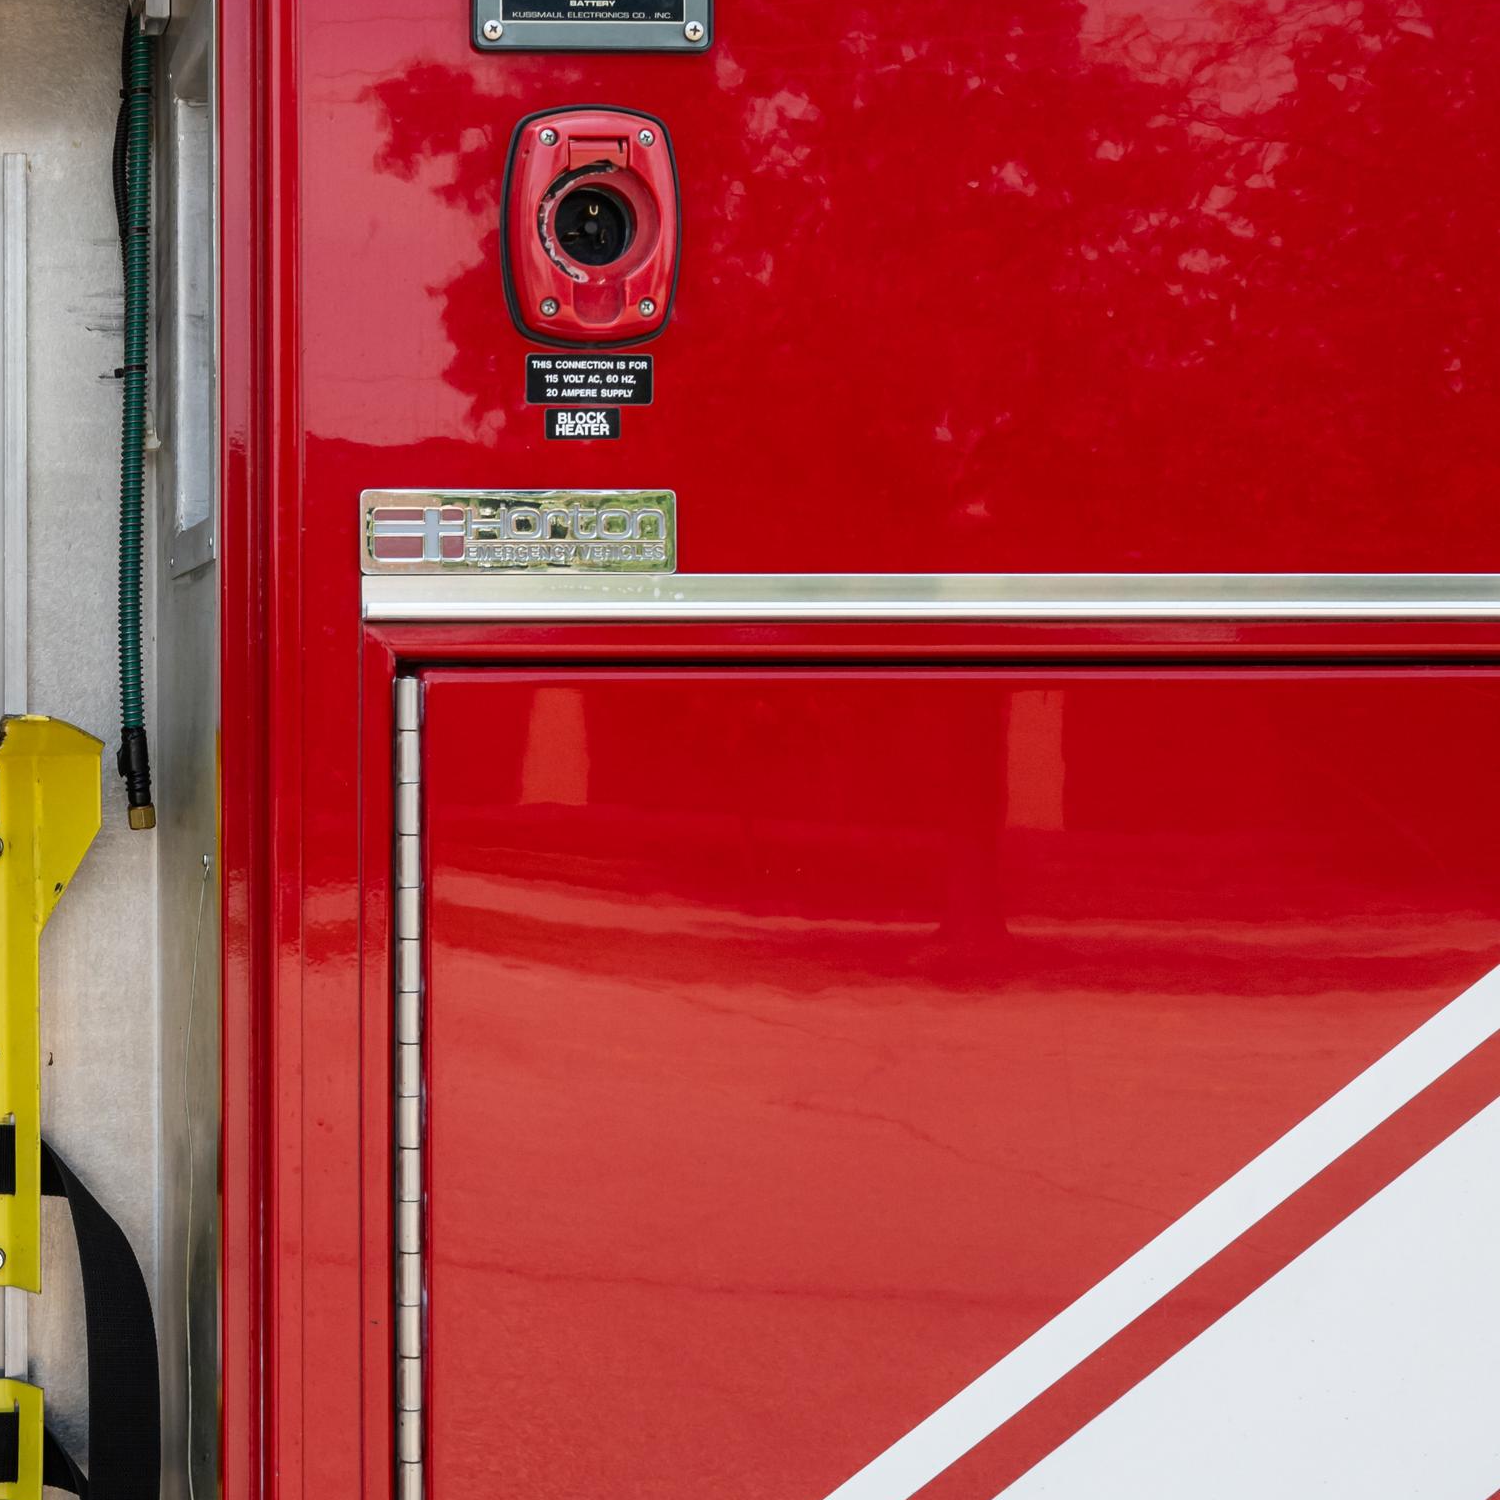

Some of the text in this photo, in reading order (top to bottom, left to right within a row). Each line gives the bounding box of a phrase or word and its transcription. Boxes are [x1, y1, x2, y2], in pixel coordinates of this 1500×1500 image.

[512, 11, 565, 19] KUSSMAUL
[567, 11, 630, 19] ELECTRONICS
[531, 360, 648, 370] THIS CONNECTION IS FOR
[544, 374, 559, 383] 115
[562, 374, 586, 384] VOLT
[587, 375, 603, 385] AC,
[605, 375, 619, 384] 60
[546, 388, 633, 398] 20 AMPERE SUPPLY
[557, 411, 607, 424] BLOCK
[555, 423, 610, 436] HEATER
[465, 503, 666, 540] Horton
[466, 545, 666, 561] EMERGENCY VEHICLES
